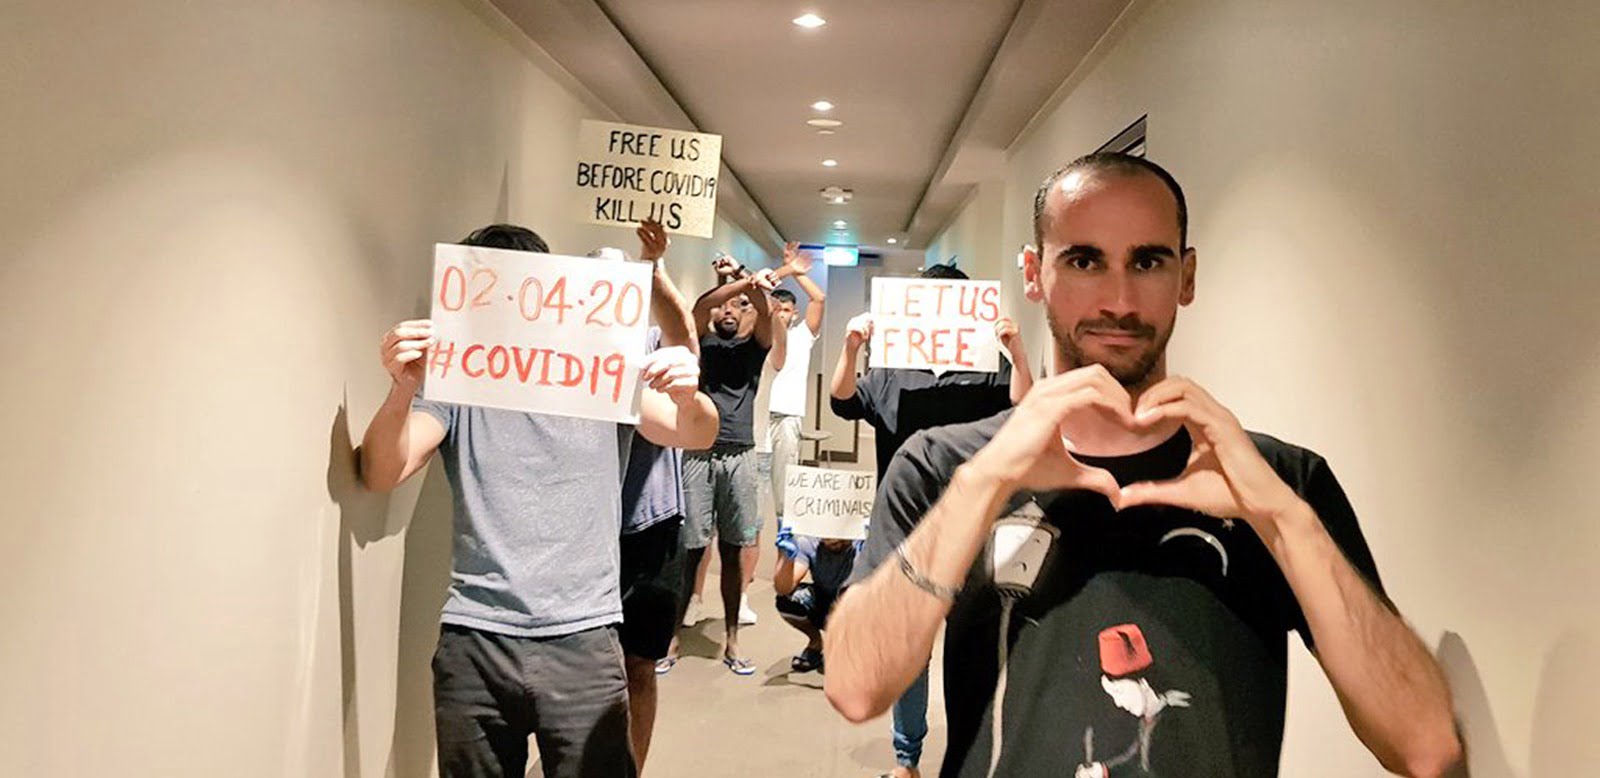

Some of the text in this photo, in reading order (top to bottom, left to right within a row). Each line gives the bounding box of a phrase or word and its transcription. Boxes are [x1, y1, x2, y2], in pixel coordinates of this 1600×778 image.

[608, 130, 700, 161] FREE US
[576, 162, 717, 199] BEFORE COVID19
[595, 196, 682, 230] KILL US
[879, 284, 999, 322] LET US
[883, 328, 976, 367] FREE
[429, 341, 627, 403] #COVID19
[788, 472, 873, 490] WE ARE NOT
[794, 496, 872, 518] CRIMINALS
